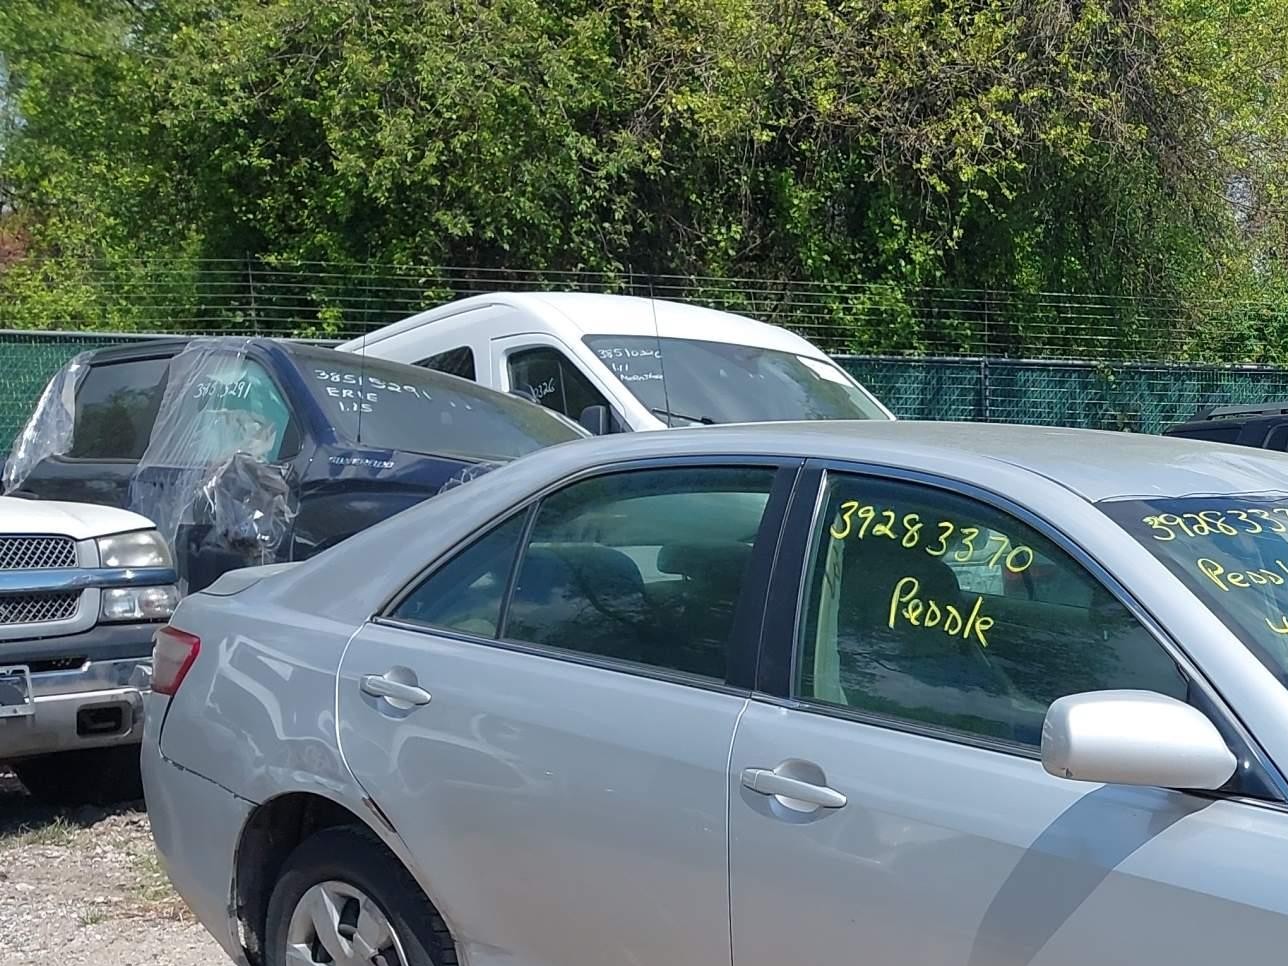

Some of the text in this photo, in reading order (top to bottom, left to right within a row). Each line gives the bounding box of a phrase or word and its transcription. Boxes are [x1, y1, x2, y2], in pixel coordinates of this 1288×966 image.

[314, 369, 432, 400] 38515291
[326, 386, 379, 402] ERIE
[830, 500, 1034, 573] 39283370
